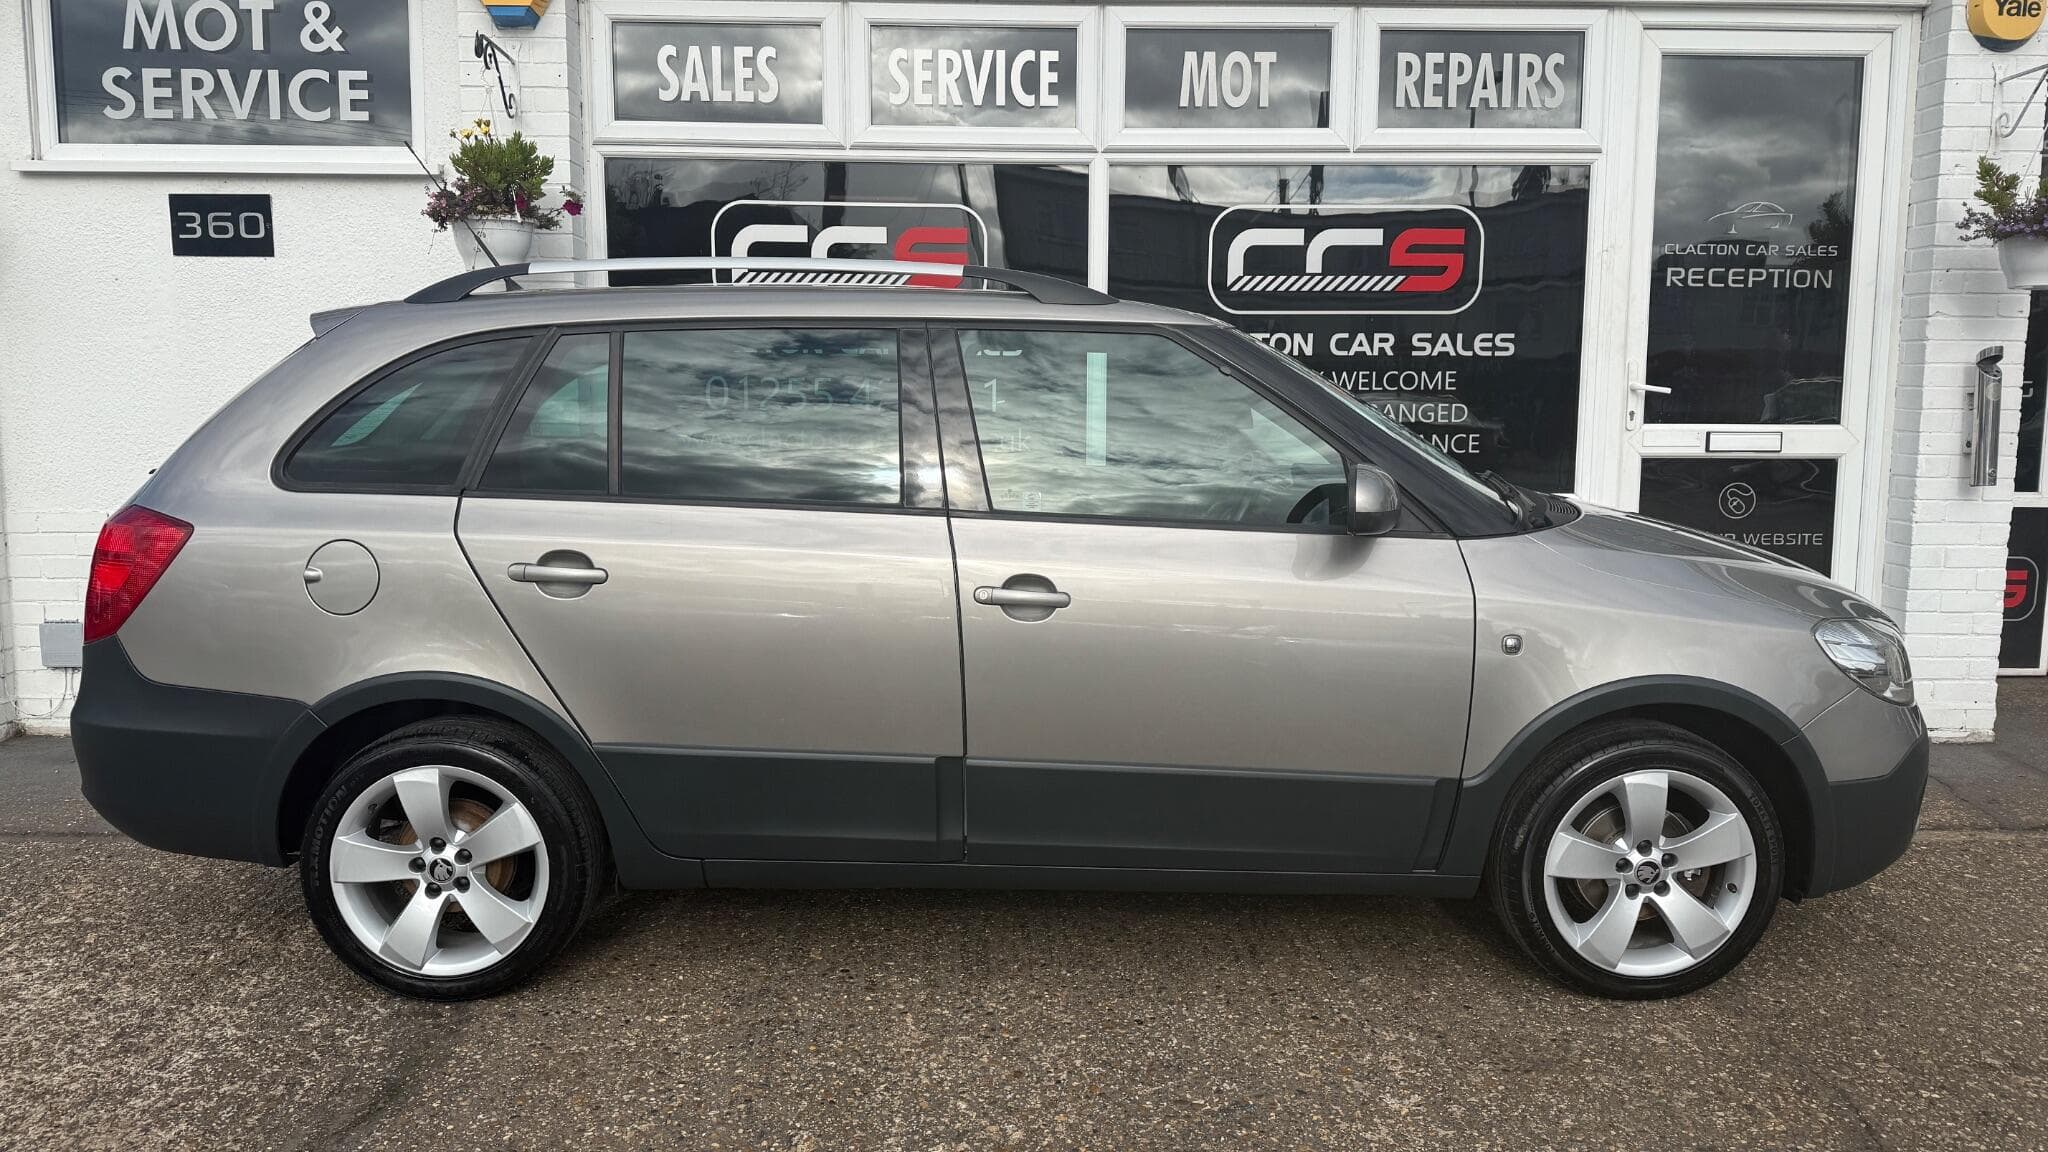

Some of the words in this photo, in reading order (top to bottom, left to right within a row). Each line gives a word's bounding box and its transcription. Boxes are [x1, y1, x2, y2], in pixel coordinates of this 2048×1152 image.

[1995, 0, 2042, 18] Yale
[122, 0, 274, 52] MOT
[299, 0, 346, 53] &
[657, 44, 779, 103] SALES
[887, 47, 1059, 107] SERVICE
[1179, 50, 1277, 108] MOT
[1395, 52, 1565, 109] REPAIRS
[101, 66, 370, 122] SERVICE
[177, 211, 266, 239] 360
[1664, 243, 1740, 256] CLACTON
[1745, 244, 1780, 257] CAR
[1785, 244, 1838, 257] SALES
[1666, 267, 1833, 288] RECEPTION
[1329, 332, 1395, 356] CAR
[1411, 332, 1515, 357] SALES
[1332, 370, 1457, 391] WELCOME
[1371, 403, 1468, 423] ANGED
[1419, 433, 1480, 453] NCE
[1743, 533, 1823, 545] WEBSITE
